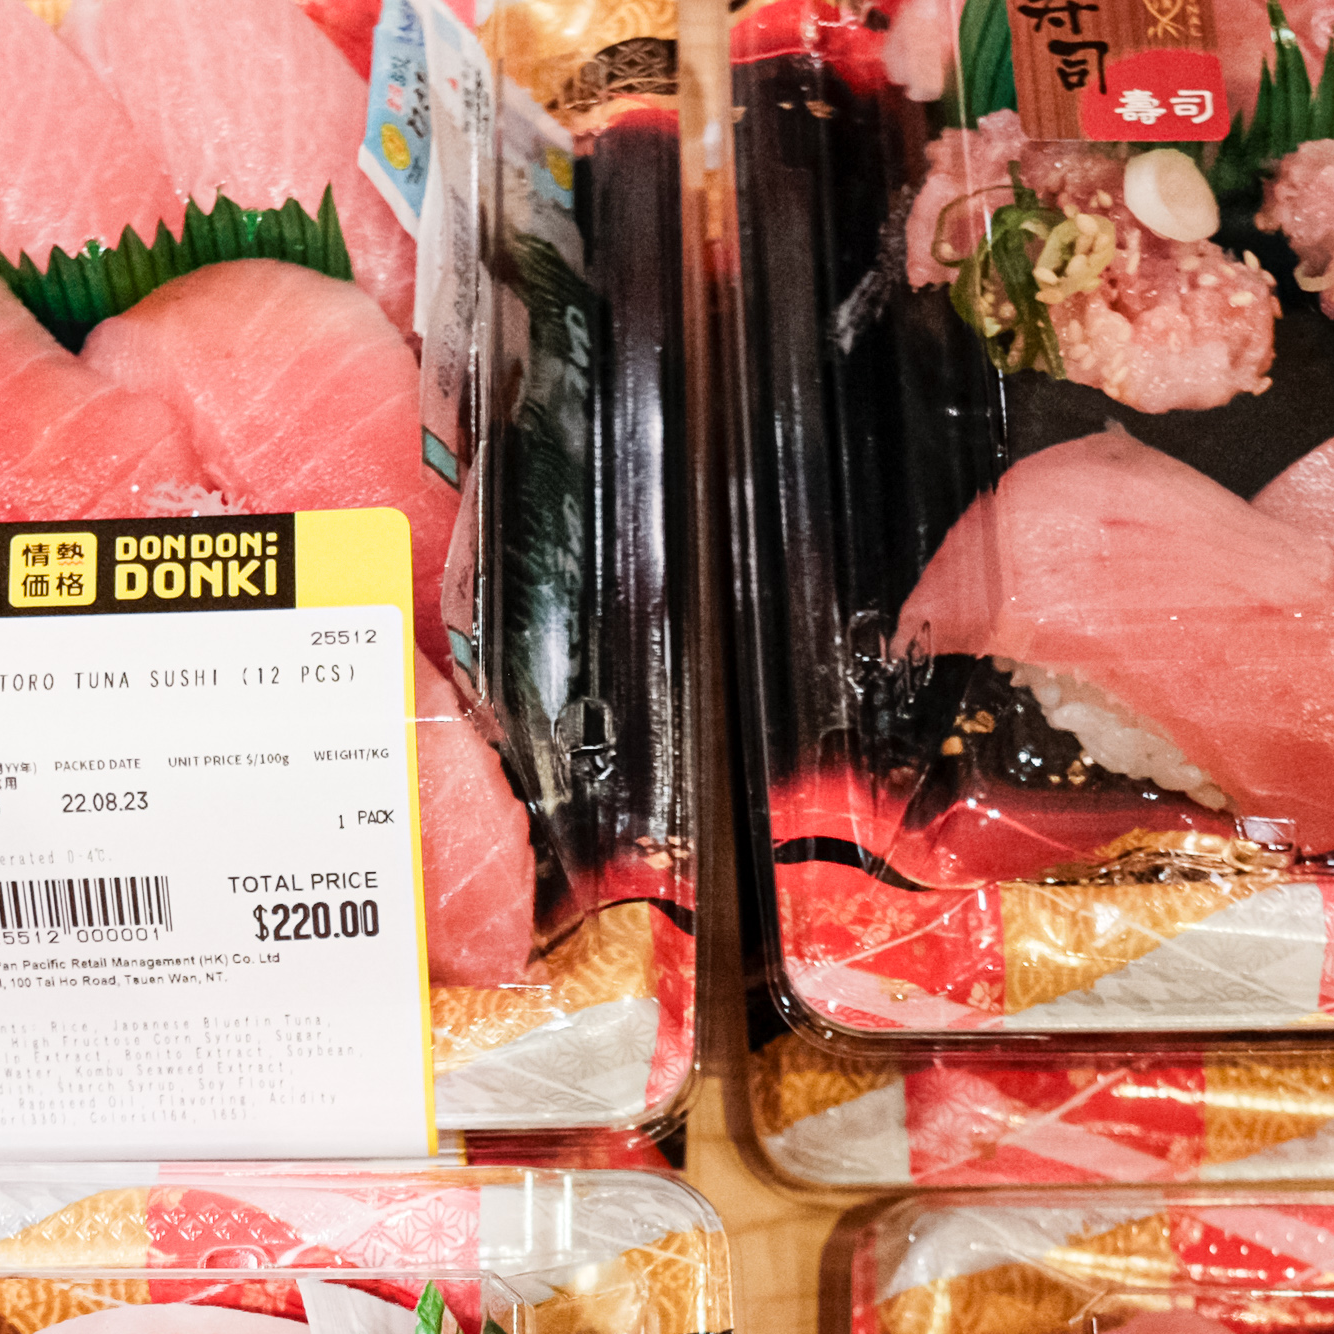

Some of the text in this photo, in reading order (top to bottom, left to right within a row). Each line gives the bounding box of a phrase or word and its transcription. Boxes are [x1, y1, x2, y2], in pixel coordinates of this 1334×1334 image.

[21, 572, 85, 598] 価格
[114, 561, 277, 600] DONKI
[310, 629, 377, 646] 25512
[74, 671, 130, 690] TUNA
[150, 668, 217, 688] SUSHI
[242, 665, 280, 686] (12
[301, 664, 355, 683] PCS)
[168, 752, 290, 768] UNIT PRICE $/100g
[313, 748, 389, 761] WEIGHT/KG
[54, 758, 141, 772] PACKED DATE
[61, 790, 149, 813] 22.08.23
[338, 809, 395, 830] 1 PACK
[227, 871, 379, 894] TOTAL PRICE
[252, 899, 380, 942] $220.00
[76, 926, 160, 944] 000001
[22, 958, 66, 970] Pacific
[71, 957, 107, 969] Retail
[111, 955, 195, 970] Management
[199, 953, 229, 968] (HK)
[232, 953, 257, 964] Co.
[259, 952, 281, 964] Ltd
[10, 977, 32, 989] 100
[35, 976, 56, 988] Tai
[59, 977, 78, 987] Ho
[81, 974, 122, 988] Road,
[168, 973, 202, 985] Wan,
[205, 971, 229, 983] NT.
